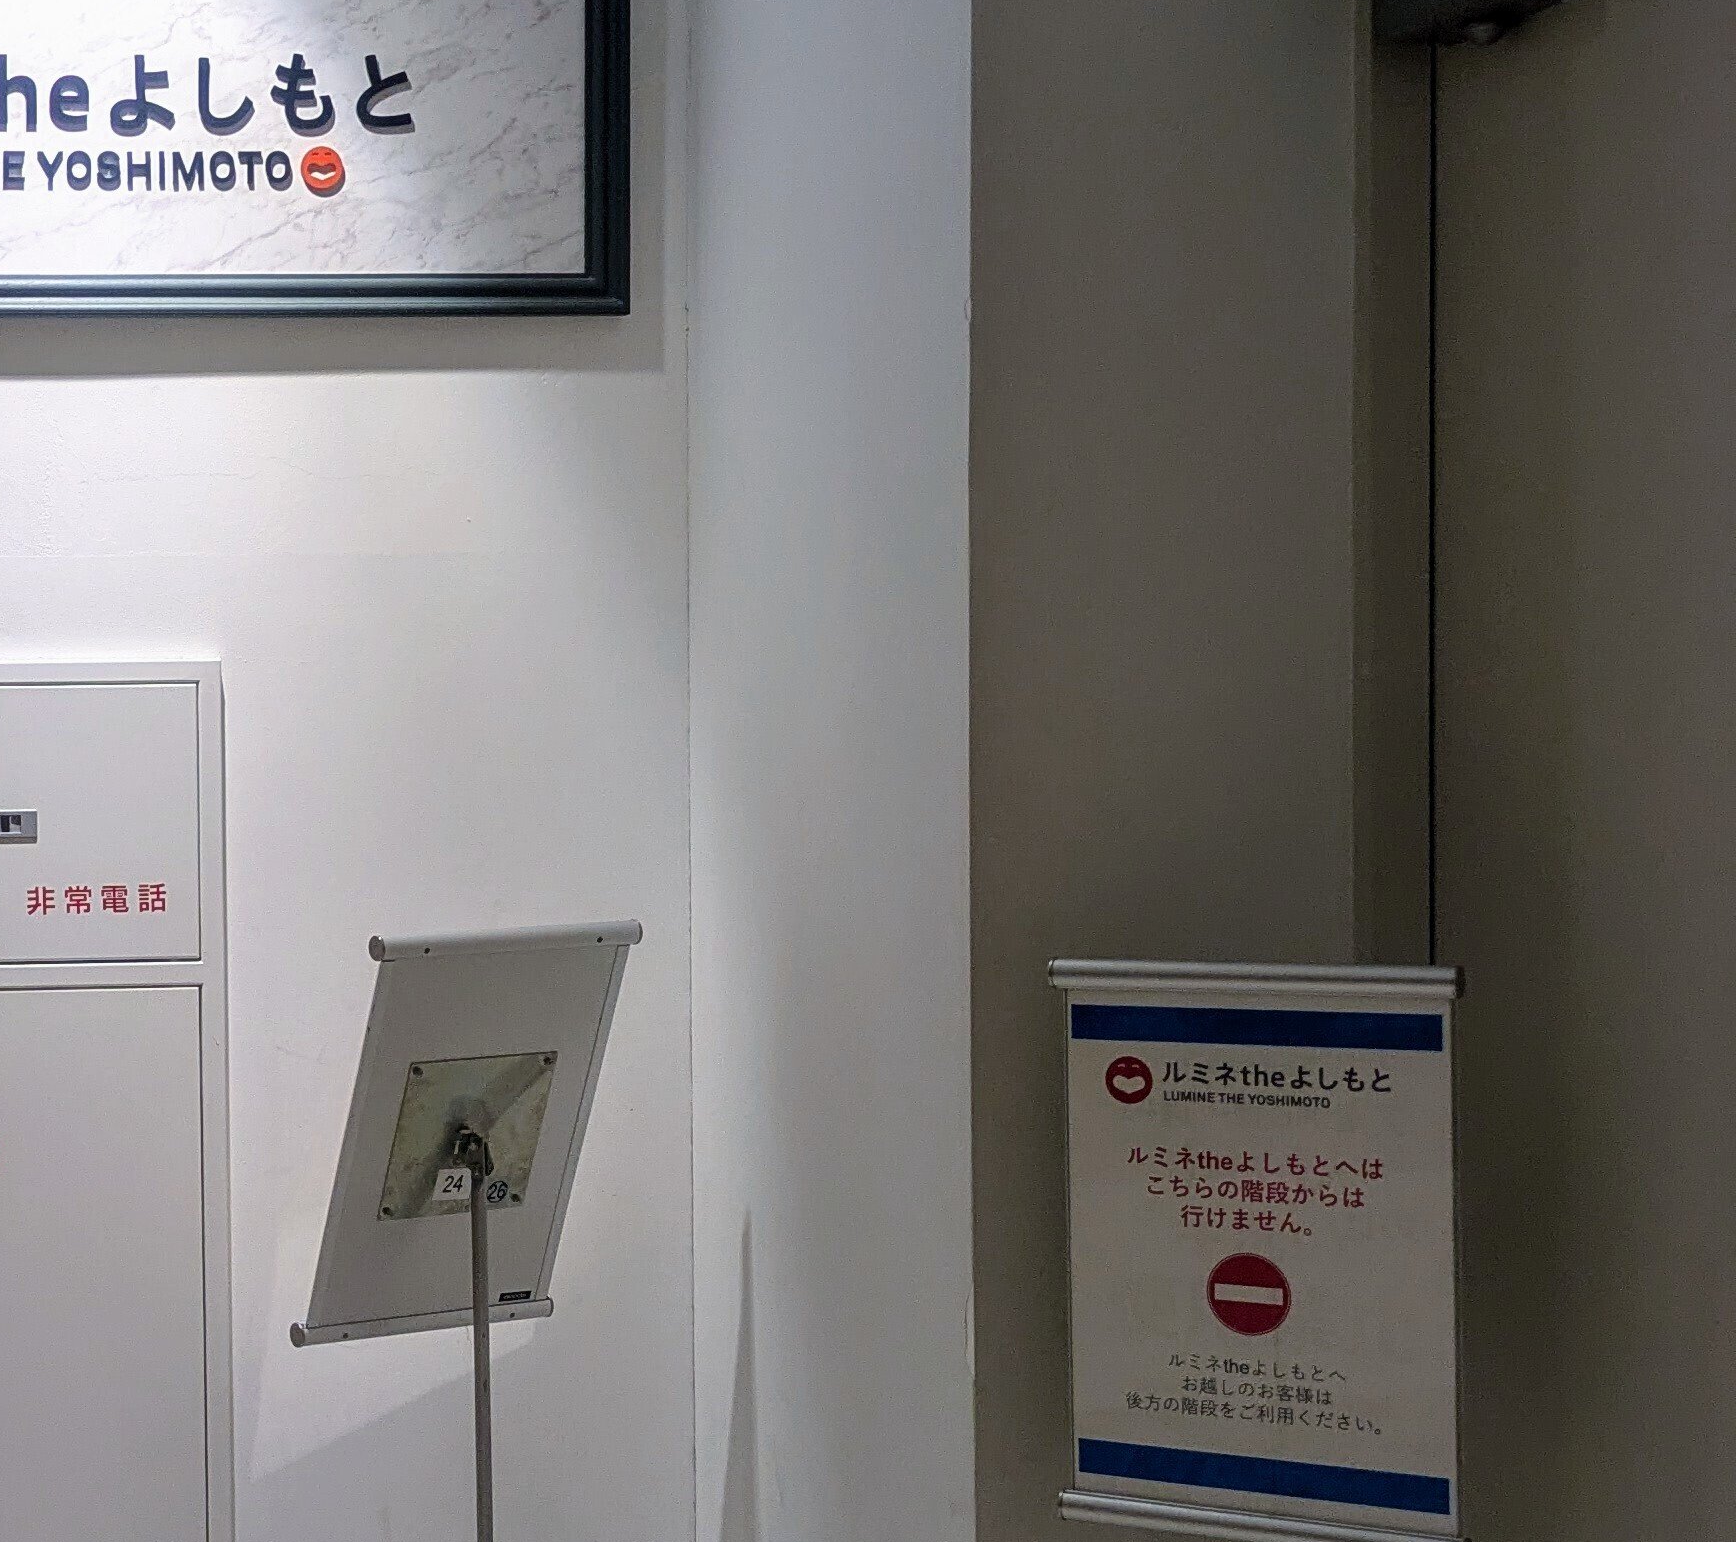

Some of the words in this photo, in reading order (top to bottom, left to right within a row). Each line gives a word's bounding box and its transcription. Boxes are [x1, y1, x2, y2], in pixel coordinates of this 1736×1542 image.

[36, 150, 293, 192] YOSHIMOTO
[26, 883, 167, 916] 非常電話
[1162, 1061, 1392, 1094] ルミネtheよしもと
[1163, 1089, 1216, 1104] LUMINE
[1218, 1091, 1245, 1105] THE
[1247, 1092, 1331, 1109] YOSHIMOTO
[1126, 1146, 1384, 1180] ルミネtheよしもとへは
[442, 1174, 464, 1194] 24
[1146, 1174, 1365, 1209] こちらの階段からは
[1180, 1204, 1313, 1237] 行けません。
[1168, 1353, 1346, 1382] ルミネtheよしもとへ
[1181, 1376, 1333, 1405] お越しのお客様は
[1125, 1391, 1382, 1436] 後方の階段をご利用ください。
